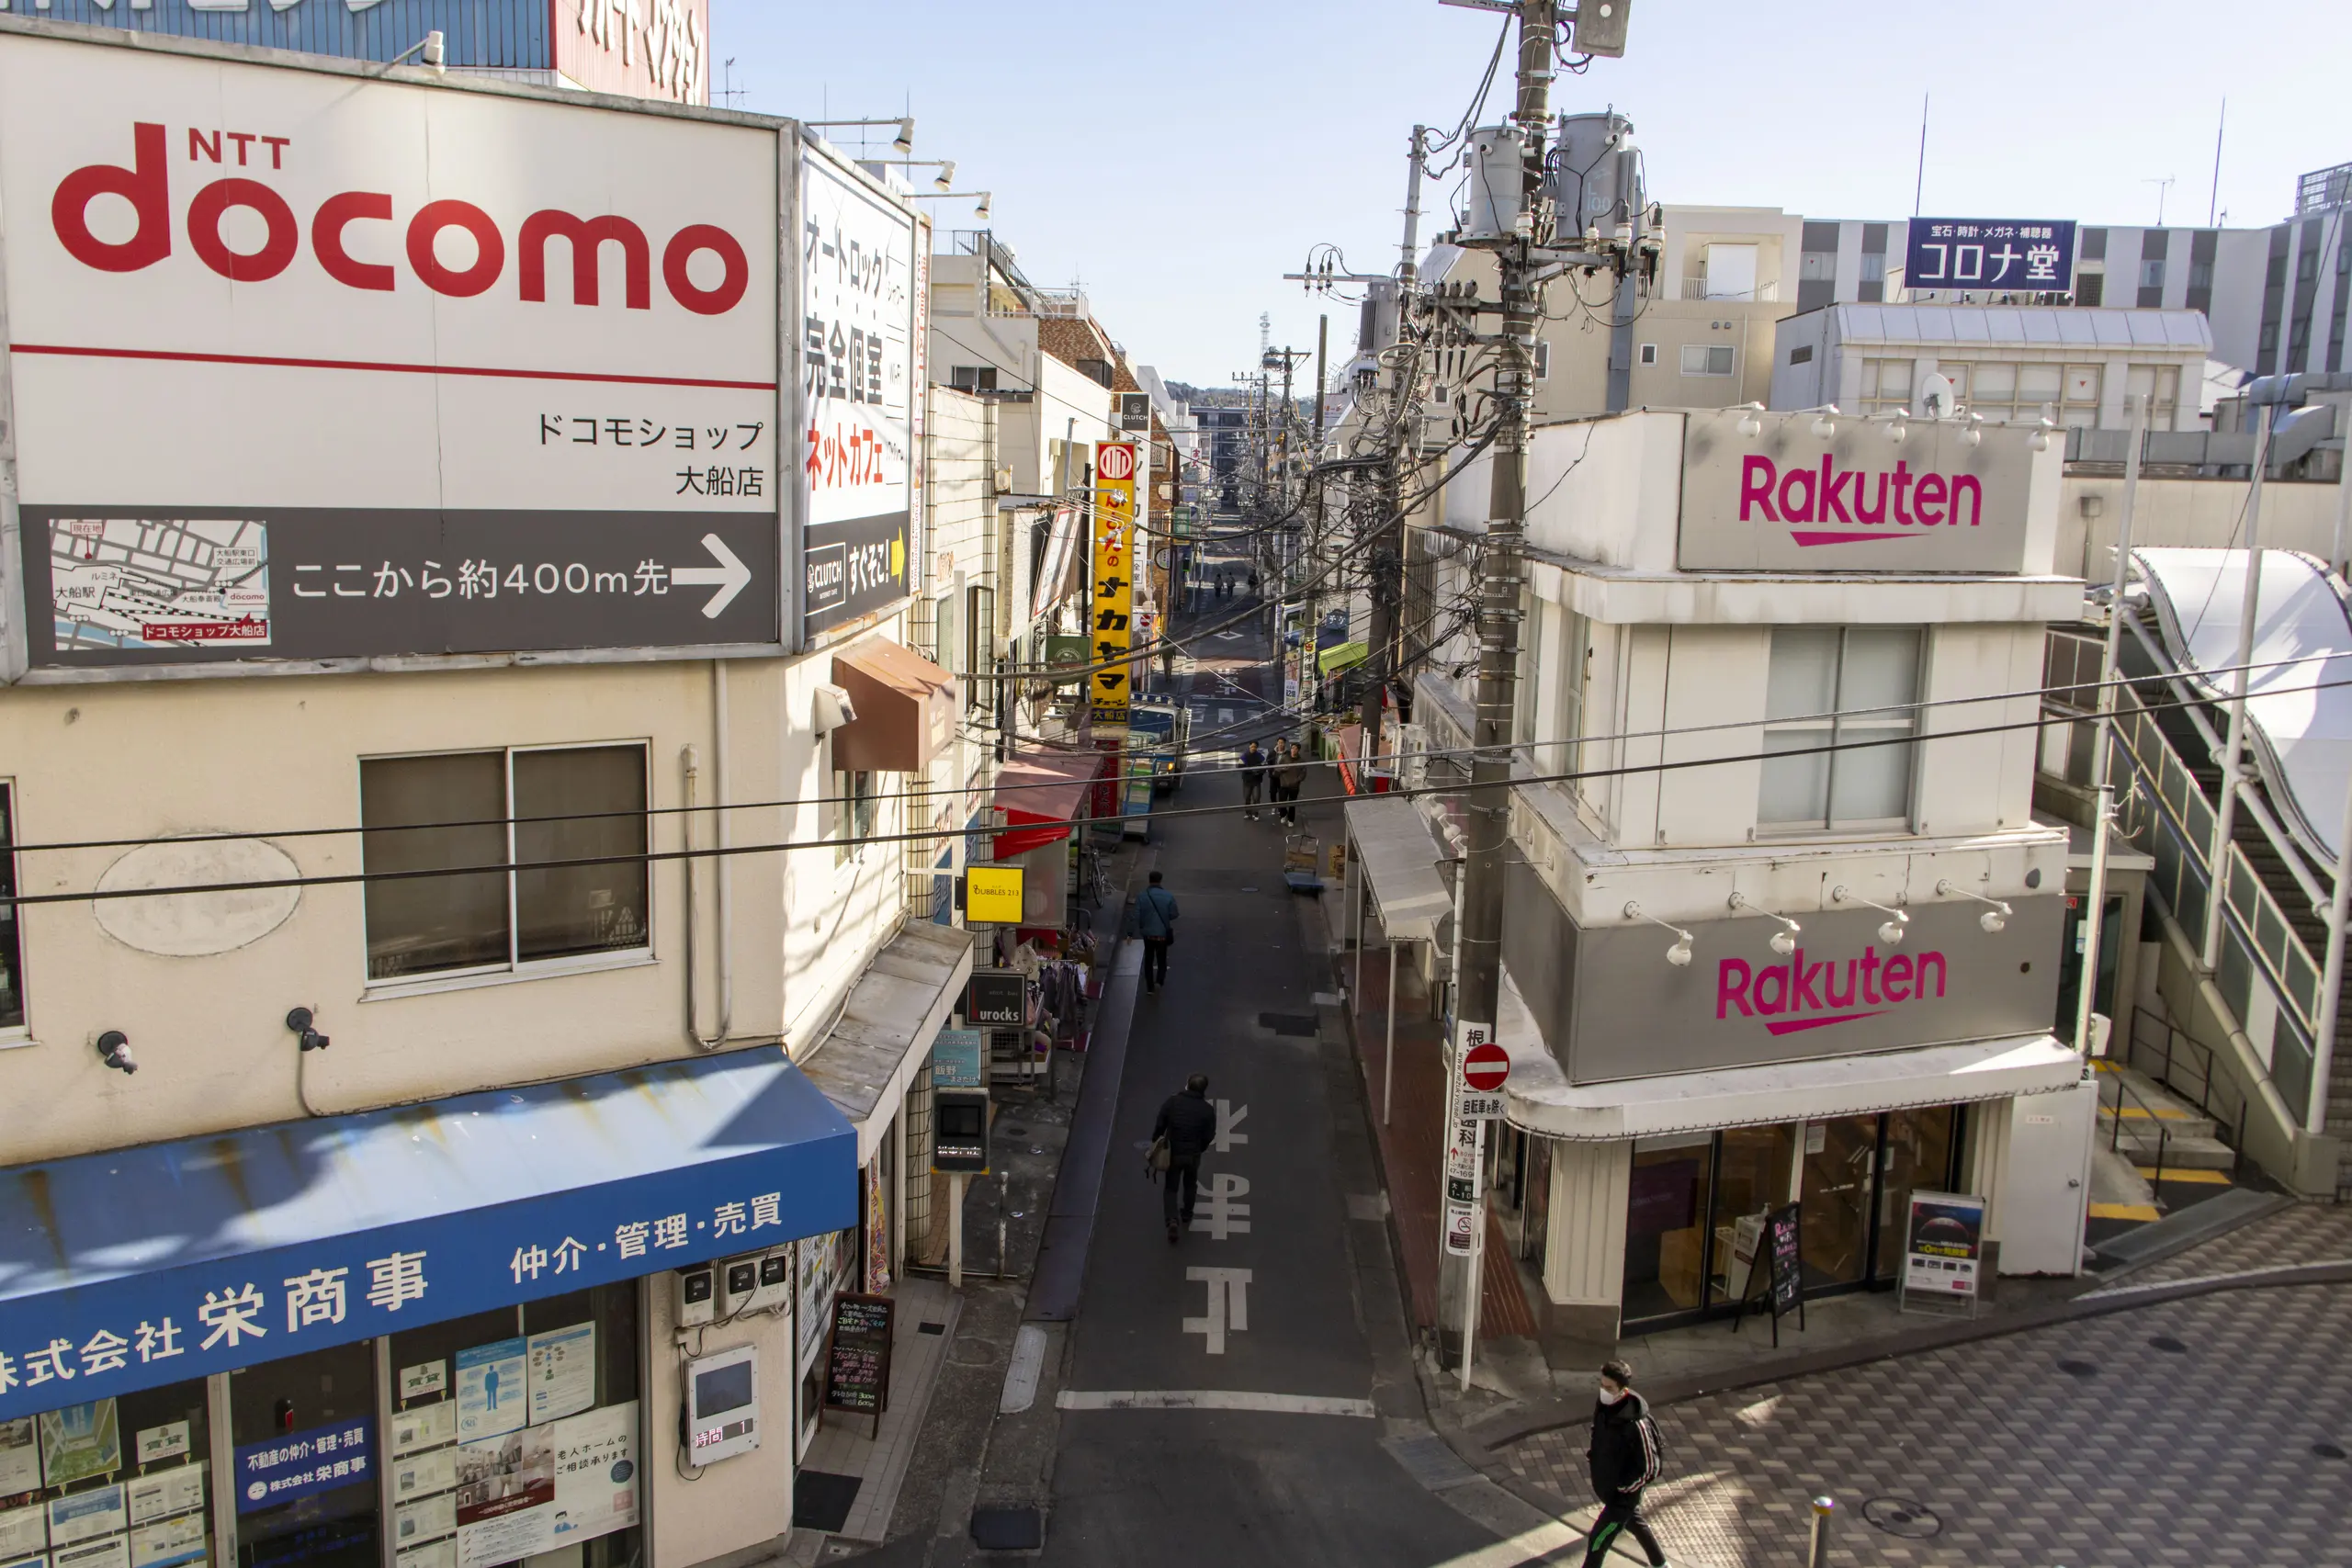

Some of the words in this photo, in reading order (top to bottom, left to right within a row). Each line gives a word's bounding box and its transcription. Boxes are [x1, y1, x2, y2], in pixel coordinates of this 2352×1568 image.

[188, 127, 289, 170] NTT
[51, 121, 749, 316] docomo
[806, 212, 882, 299] オートロック
[1919, 243, 2060, 282] コロナ堂
[806, 313, 883, 406] 完全個室
[539, 412, 763, 453] ドコモショップ
[806, 418, 883, 491] ネットカフェ
[675, 466, 763, 498] 大船店
[1739, 453, 1982, 526] Rakuten
[73, 523, 102, 534] 現在地
[55, 586, 96, 599] 大船駅
[92, 571, 119, 581] ルミネ
[293, 558, 669, 602] ここから約400m先
[815, 559, 842, 588] CLUTCH
[230, 592, 266, 601] docomo
[144, 625, 266, 638] ドコモショップ大船店
[1096, 577, 1129, 690] ナカヤマ
[1093, 697, 1126, 706] チェーン
[1093, 710, 1125, 720] 大船店
[1716, 946, 1947, 1019] Rakuten
[1463, 1099, 1505, 1114] 自転車を除く
[510, 1191, 783, 1284] 仲介・管理・売買
[198, 1250, 429, 1351] 栄商事
[247, 1427, 365, 1472] 不動産の仲介・管理・売買
[557, 1435, 627, 1461] 老人ホームの
[695, 1426, 723, 1449] 時間
[269, 1472, 314, 1493] 株式会社
[316, 1456, 367, 1482] 栄商事
[557, 1448, 628, 1475] ご相談承ります
